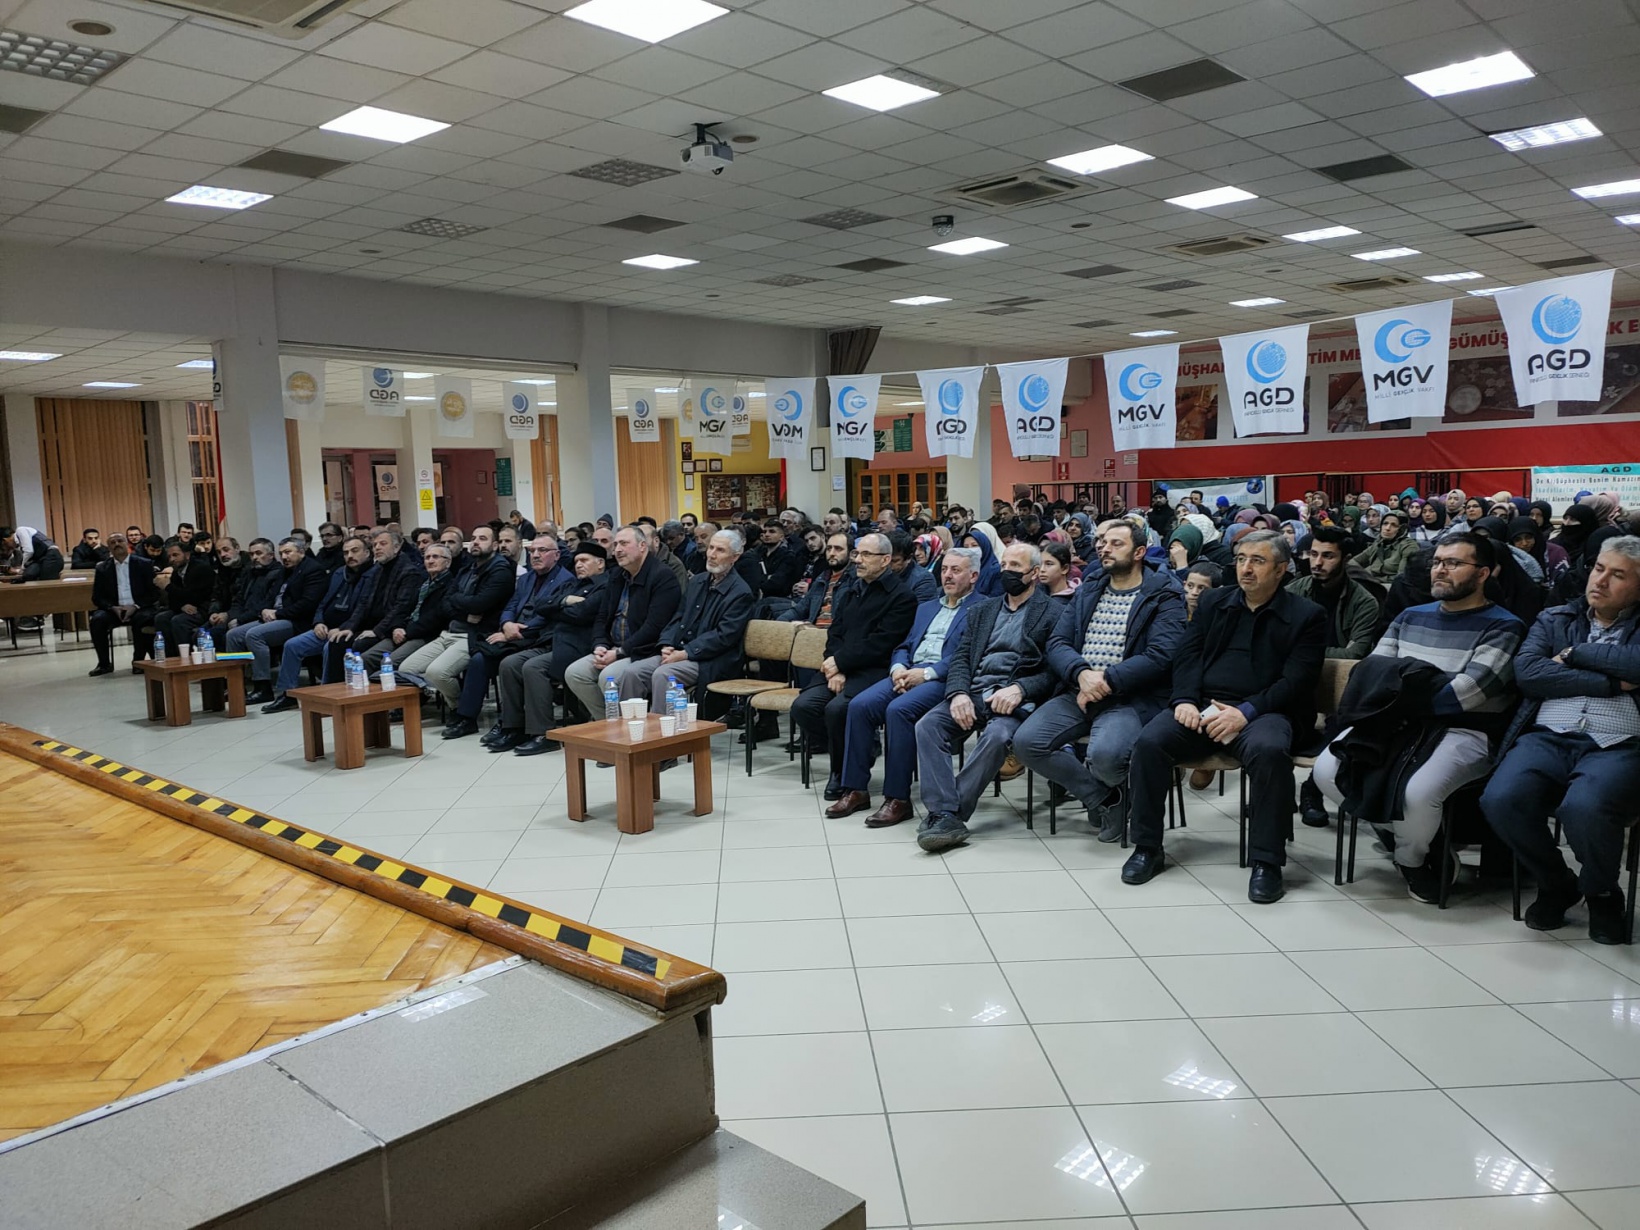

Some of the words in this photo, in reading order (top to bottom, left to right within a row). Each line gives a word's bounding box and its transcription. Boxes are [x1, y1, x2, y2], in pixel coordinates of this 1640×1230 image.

[1178, 362, 1225, 379] ÜŞHA
[1450, 330, 1508, 349] GÜMÜŞ
[1528, 349, 1591, 376] AGD
[1373, 365, 1434, 391] MGV
[1244, 387, 1294, 409] AGD
[1118, 404, 1165, 424] MGV
